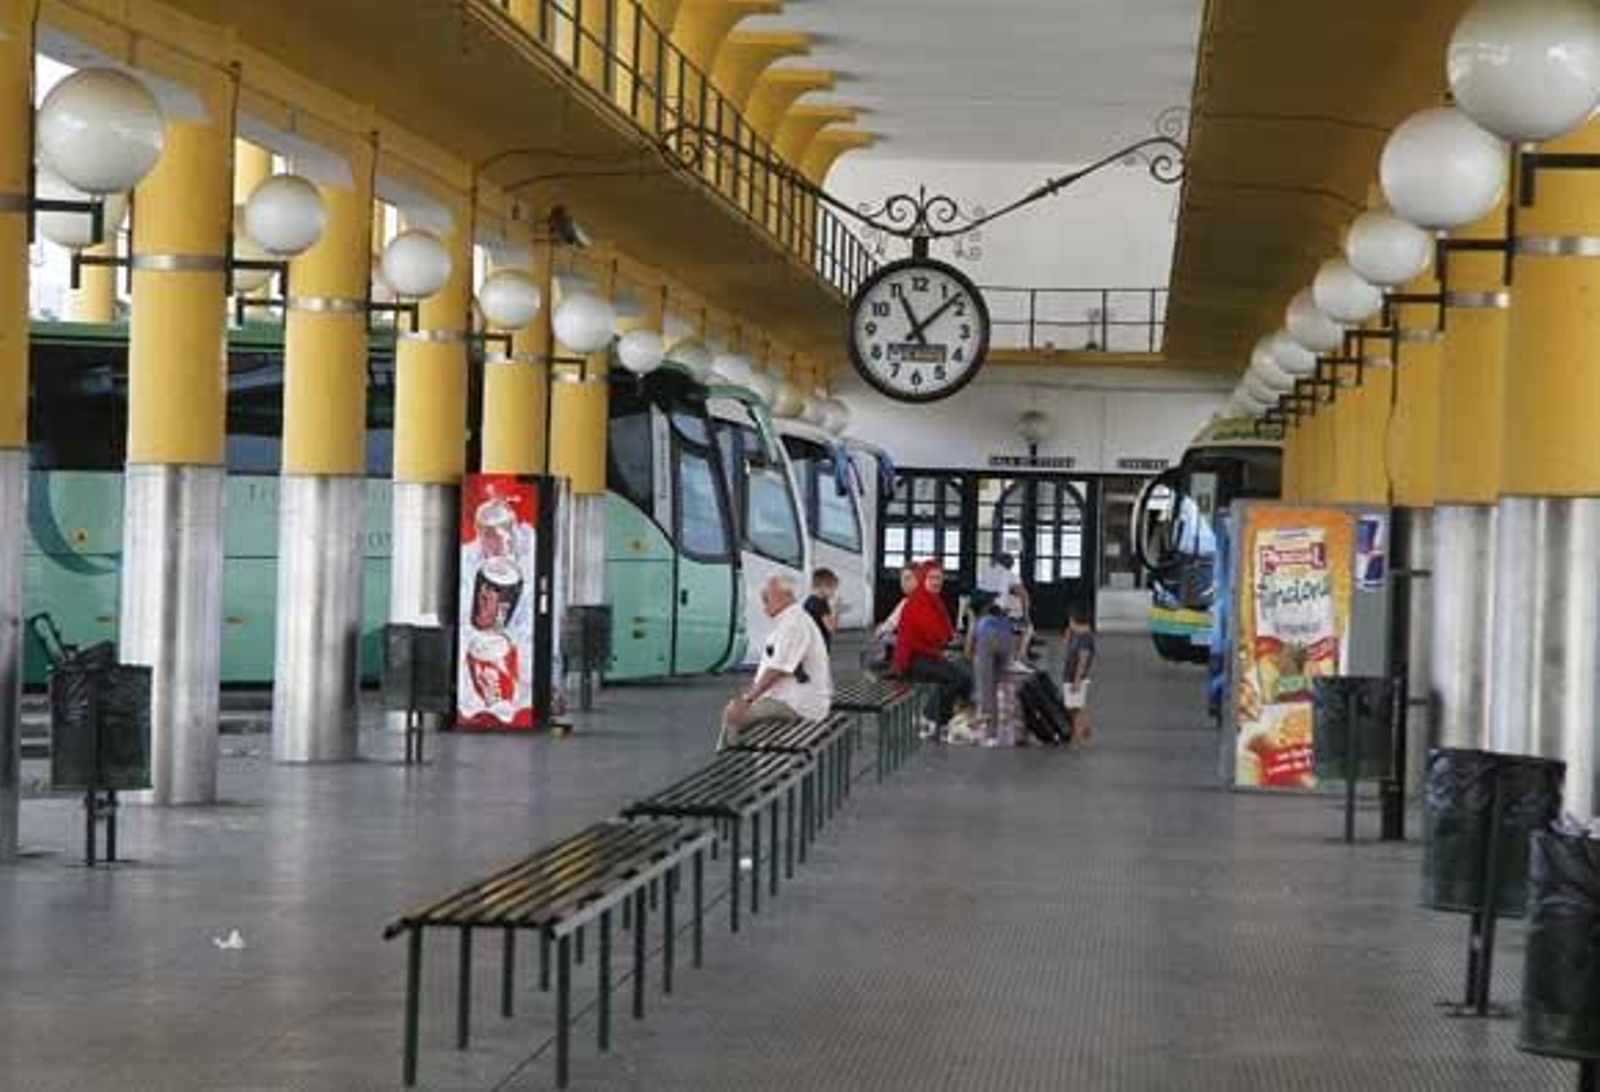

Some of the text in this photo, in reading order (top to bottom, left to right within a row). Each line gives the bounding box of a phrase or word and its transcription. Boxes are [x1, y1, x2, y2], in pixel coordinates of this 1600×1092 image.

[912, 277, 928, 292] 12
[872, 302, 889, 317] 10
[955, 302, 965, 316] 2
[865, 322, 876, 335] 9
[959, 324, 970, 340] 3
[871, 345, 882, 360] 8
[951, 347, 963, 362] 4
[890, 363, 900, 377] 7
[911, 369, 922, 386] 6
[934, 365, 946, 380] 5
